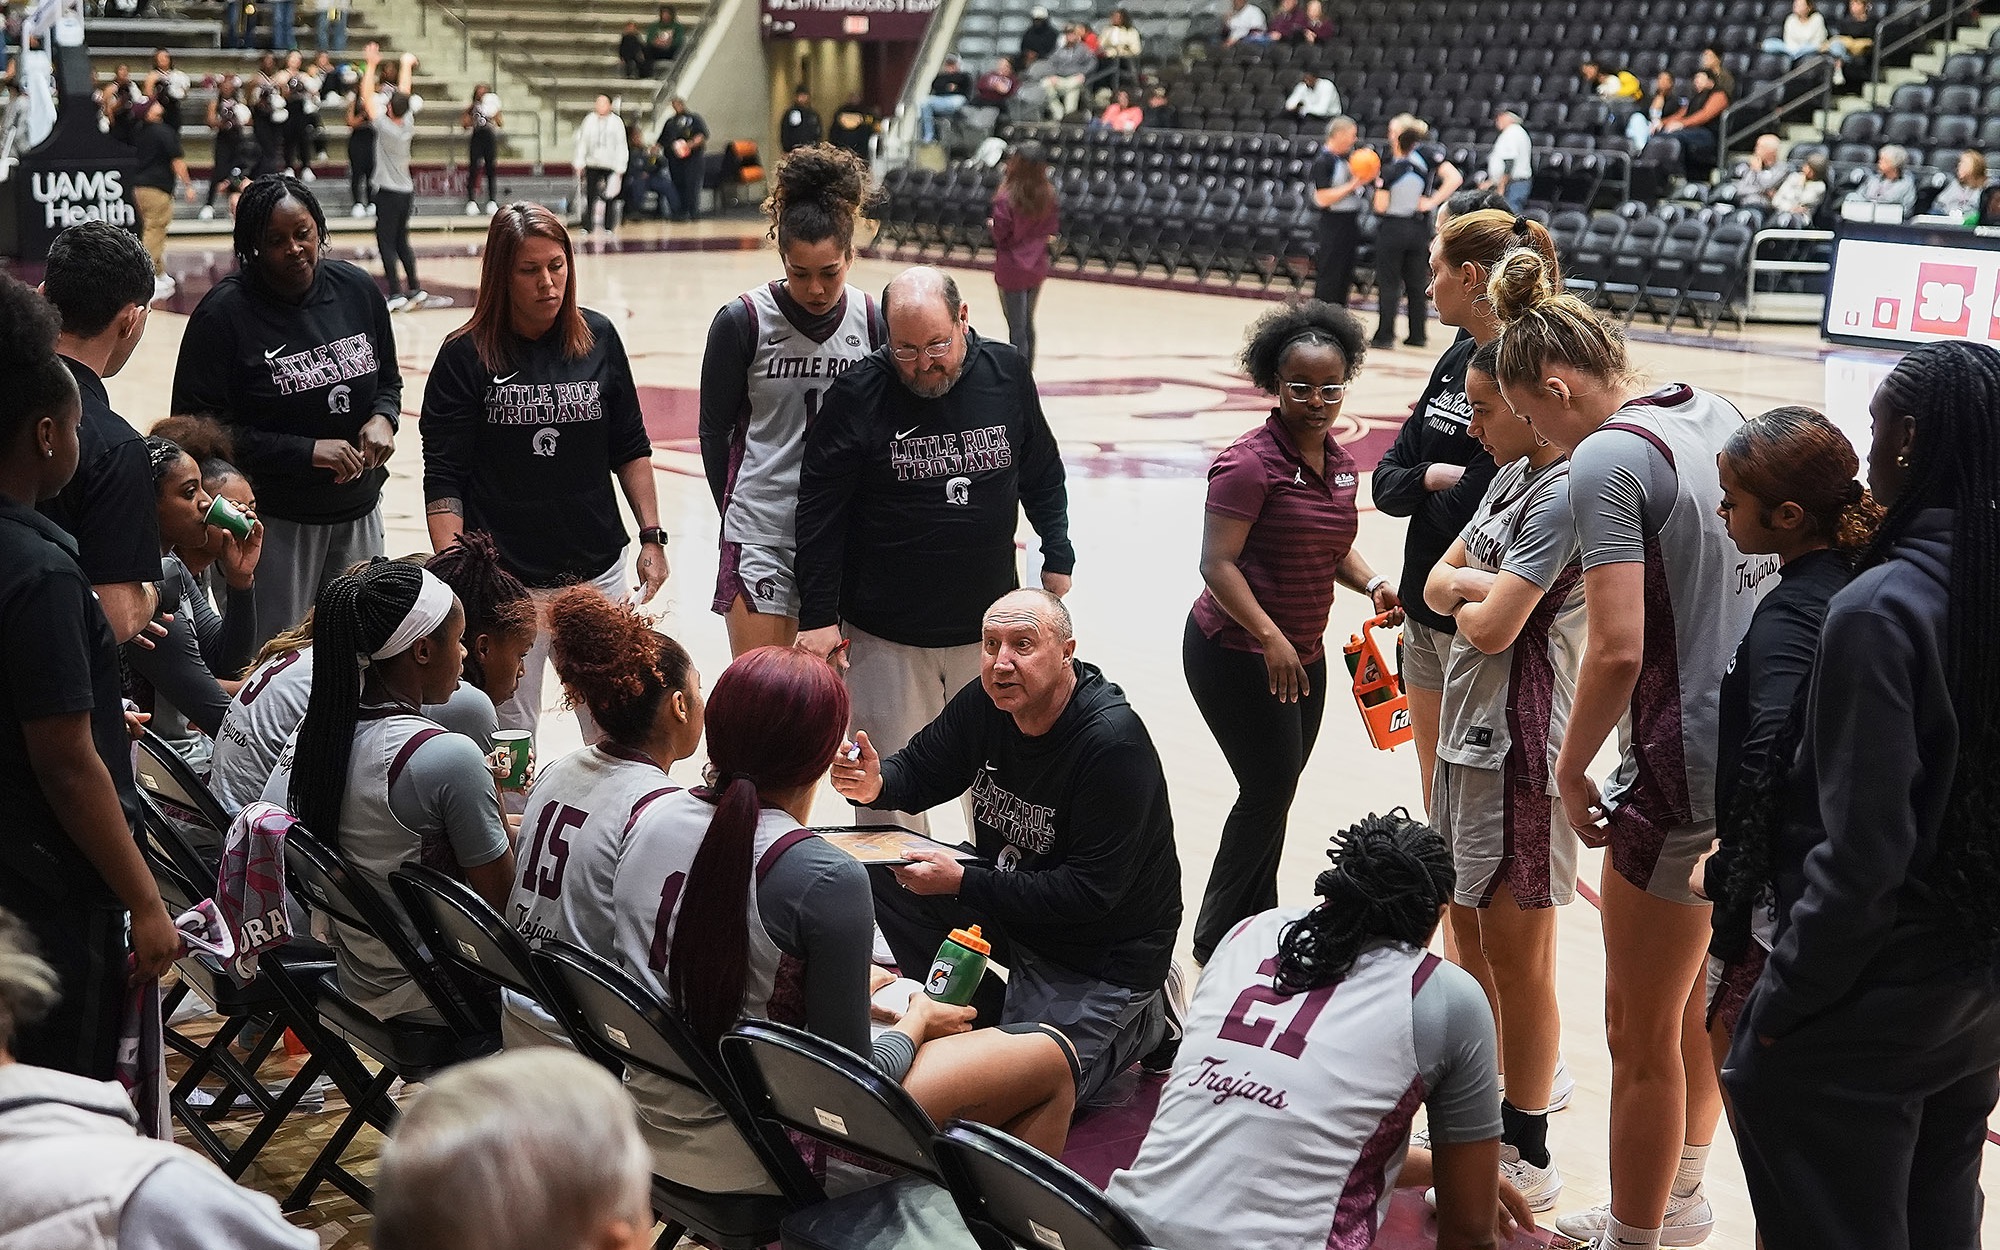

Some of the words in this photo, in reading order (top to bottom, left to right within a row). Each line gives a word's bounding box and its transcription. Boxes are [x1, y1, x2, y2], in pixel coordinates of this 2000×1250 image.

[32, 170, 123, 203] UAMS
[45, 198, 135, 229] Health
[265, 344, 334, 377] LITTLE
[329, 333, 373, 361] ROCK
[767, 357, 822, 379] LITTLE
[273, 352, 378, 396] TROJANS
[485, 383, 553, 406] LITTLE
[554, 381, 600, 403] ROCK
[486, 401, 603, 425] TROJANS
[889, 434, 959, 462] LITTLE
[961, 425, 1010, 454] ROCK
[892, 448, 1012, 481] TROJANS
[522, 800, 590, 901] 15
[1217, 953, 1346, 1060] 21
[1189, 1056, 1289, 1109] Trojans
